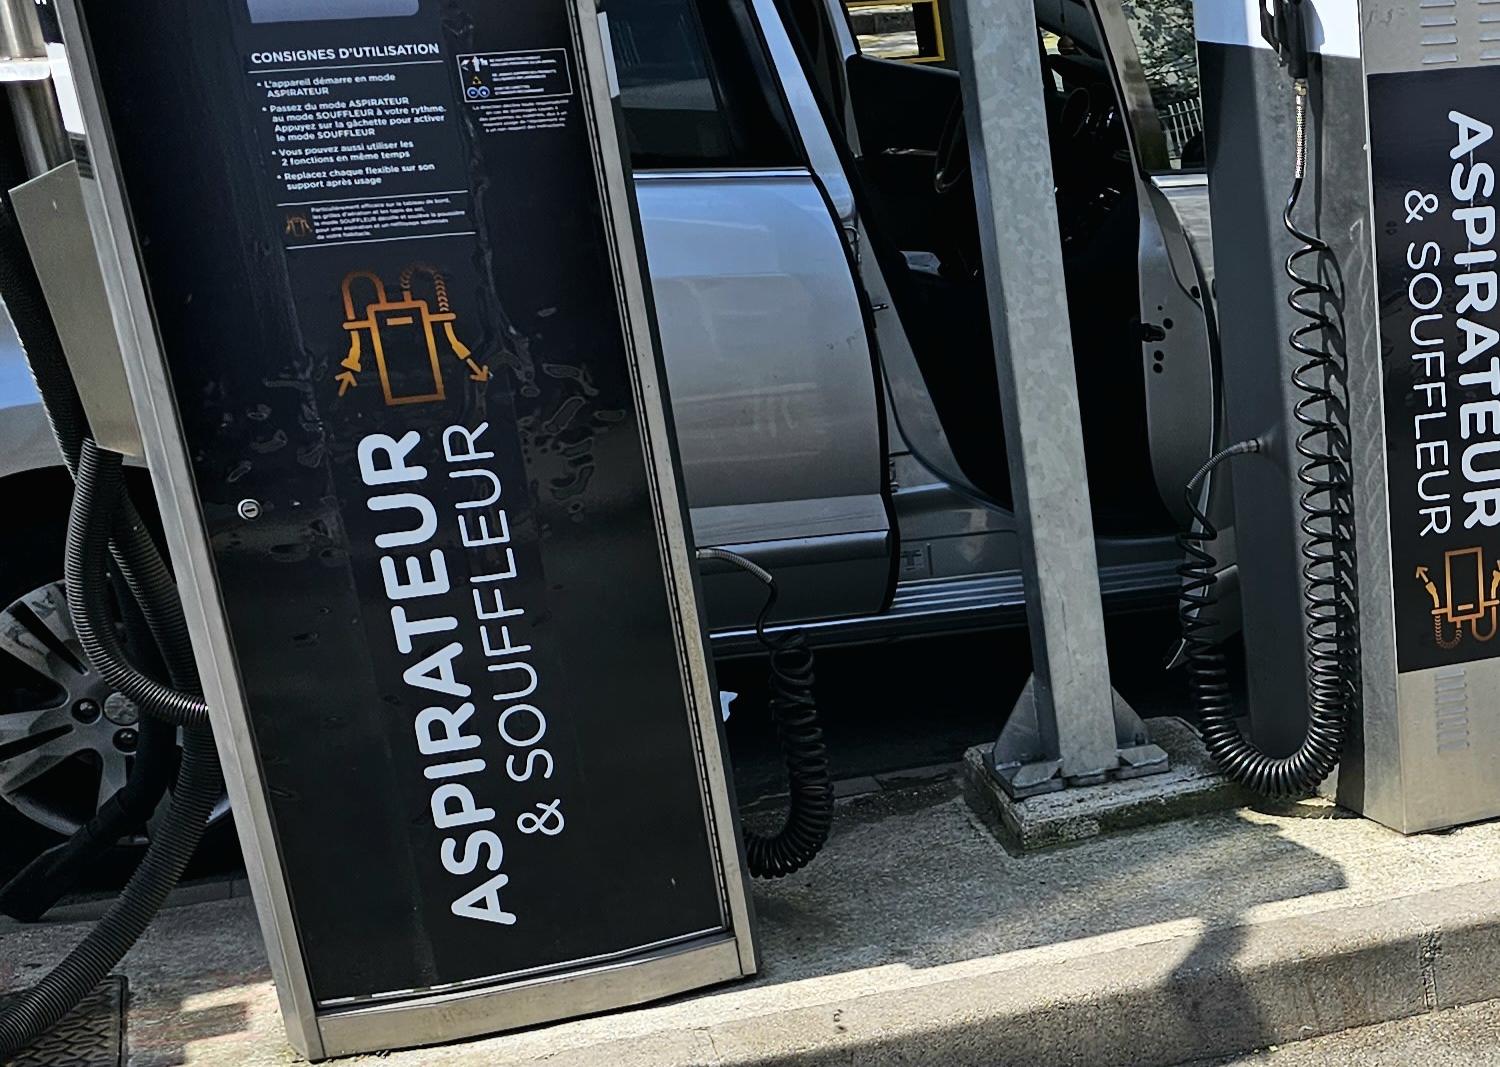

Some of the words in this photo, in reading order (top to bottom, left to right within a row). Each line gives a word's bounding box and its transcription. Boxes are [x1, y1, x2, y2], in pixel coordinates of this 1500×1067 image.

[251, 50, 335, 64] CONSIGNES
[313, 76, 352, 86] démarre
[368, 74, 396, 82] mode
[267, 87, 329, 98] ASPIRATEUR
[304, 103, 317, 111] du
[319, 101, 347, 110] mode
[349, 97, 409, 107] ASPIRATEUR
[286, 112, 314, 121] mode
[316, 109, 374, 119] SOUFFLEUR
[376, 108, 382, 116] à
[384, 107, 408, 115] votre
[275, 124, 316, 133] Appuyez
[335, 121, 344, 129] la
[389, 118, 411, 126] pour
[413, 115, 444, 124] activer
[276, 134, 285, 142] le
[288, 132, 315, 141] mode
[317, 128, 375, 139] SOUFFLEUR
[305, 147, 338, 156] pouvez
[341, 143, 364, 152] aussi
[366, 142, 398, 151] utiliser
[400, 140, 413, 148] les
[290, 155, 334, 165] fonctions
[350, 150, 379, 160] même
[381, 150, 410, 160] temps
[284, 170, 327, 181] Replacez
[329, 168, 363, 178] chaque
[365, 165, 399, 175] flexible
[418, 163, 435, 171] son
[287, 181, 324, 191] support
[326, 178, 352, 188] après
[354, 177, 382, 186] usage
[1405, 190, 1438, 223] &
[1407, 242, 1451, 536] SOUFFLEUR
[442, 421, 553, 781] SOUFFLEUR
[358, 430, 517, 924] ASPIRATEUR
[517, 799, 564, 835] &
